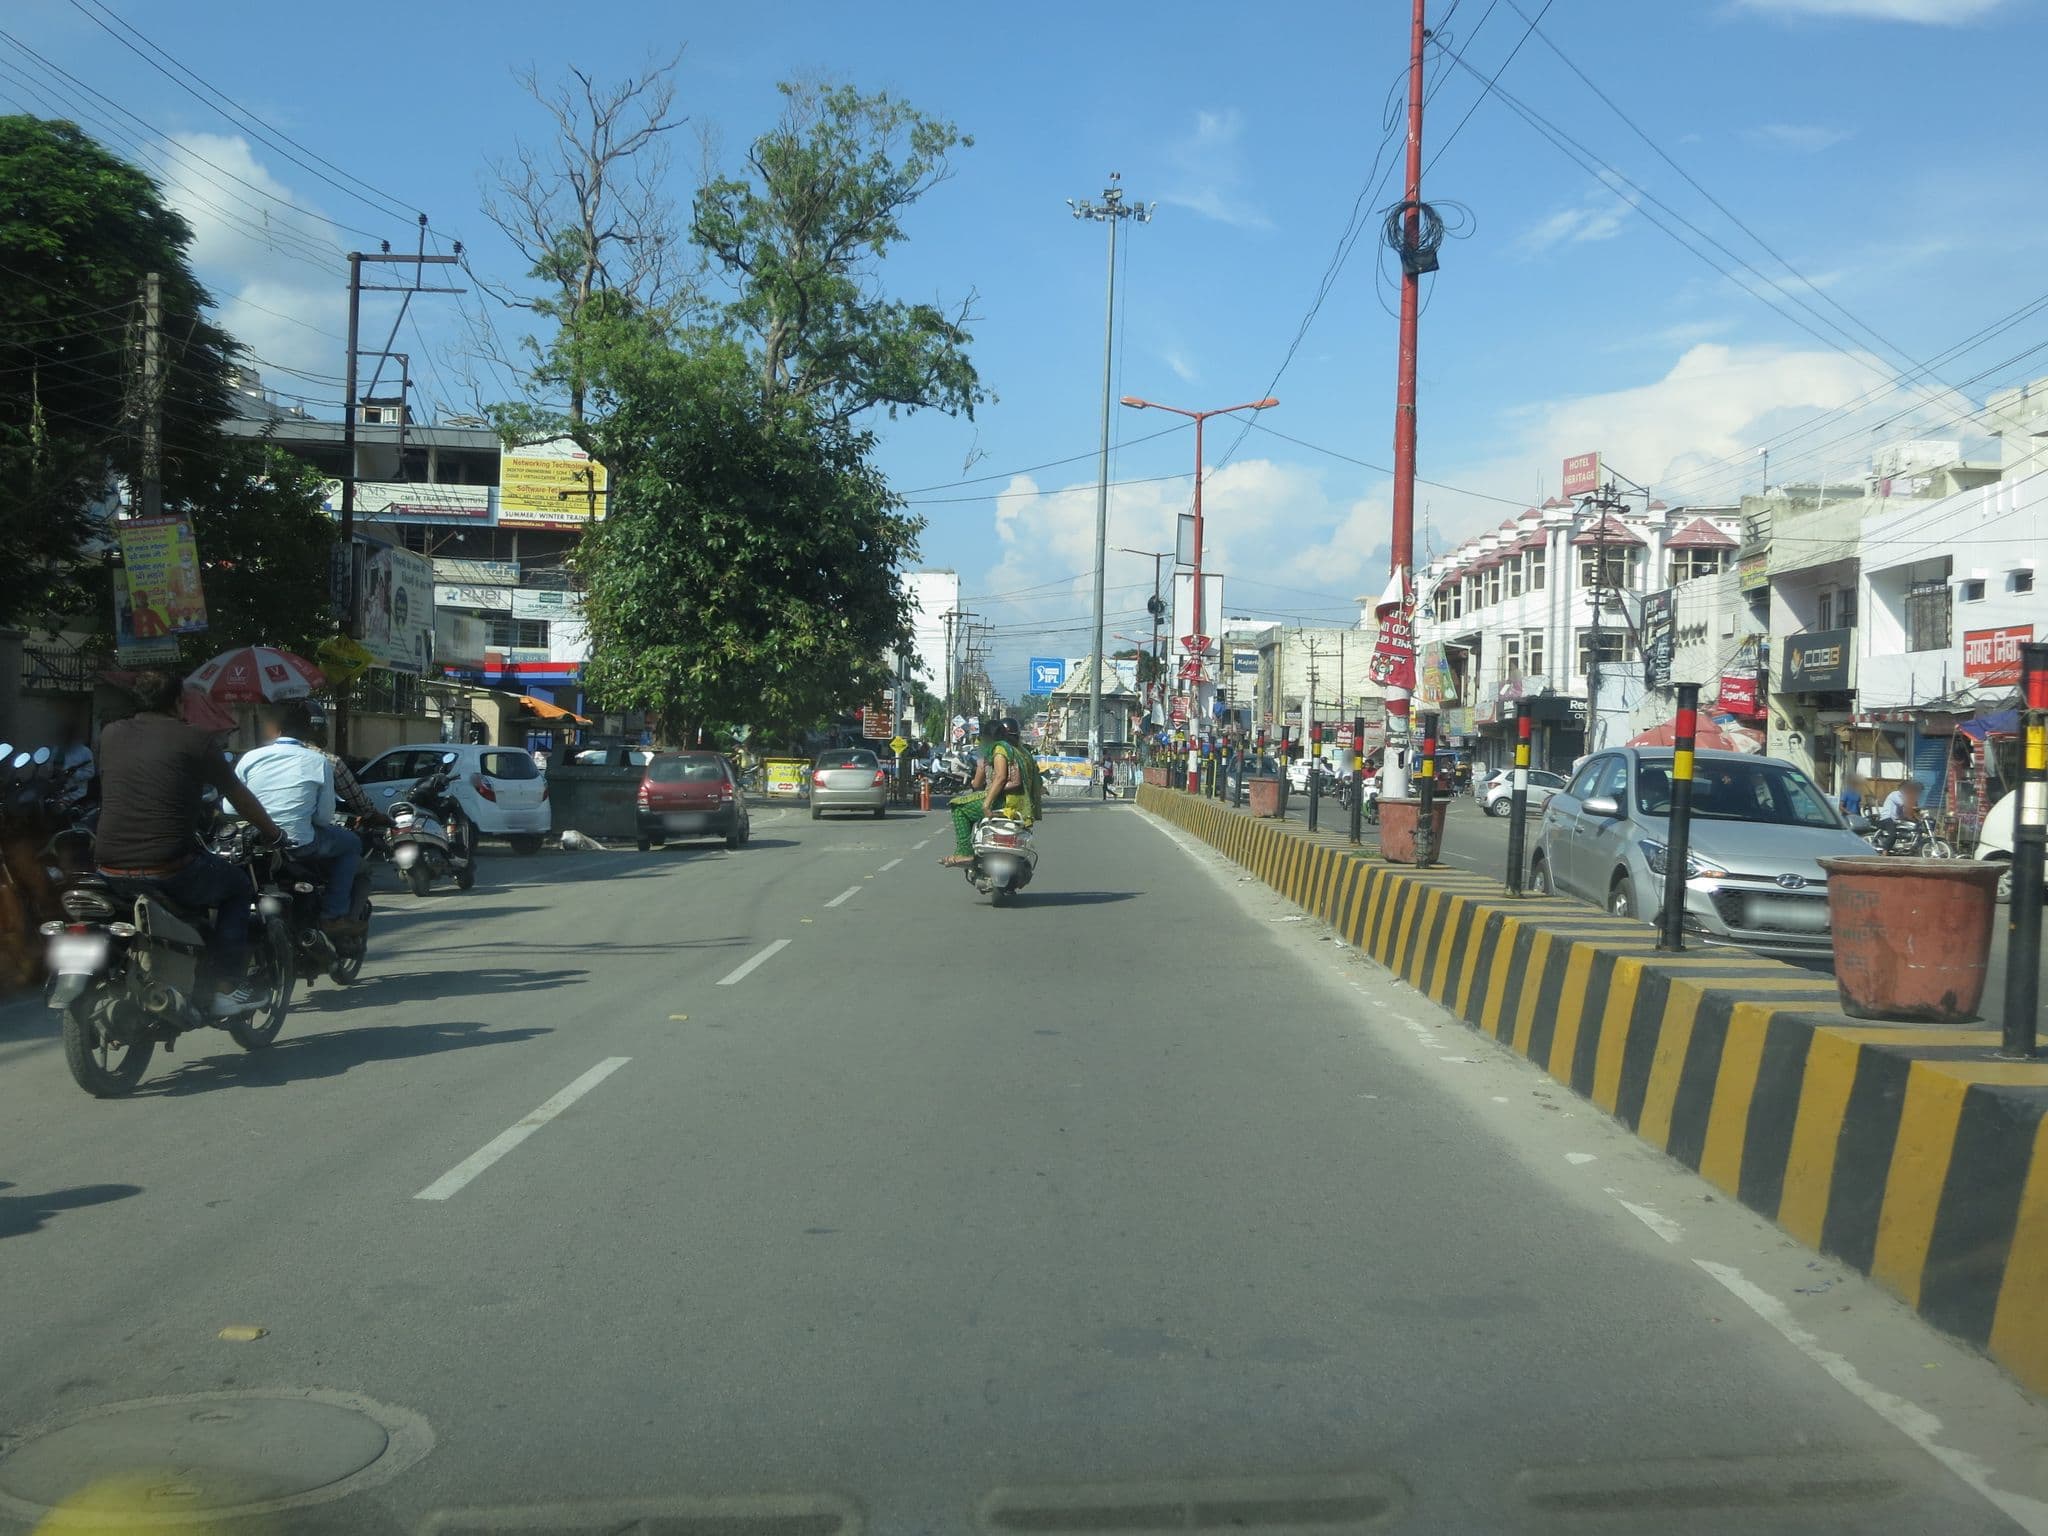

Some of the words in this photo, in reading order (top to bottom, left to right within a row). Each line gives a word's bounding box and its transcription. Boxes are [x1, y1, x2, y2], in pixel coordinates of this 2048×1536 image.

[512, 459, 550, 469] Networking
[1570, 457, 1589, 470] HOTEL
[1564, 470, 1595, 485] HERITAGE
[517, 485, 545, 494] Software
[1045, 674, 1059, 683] IPL
